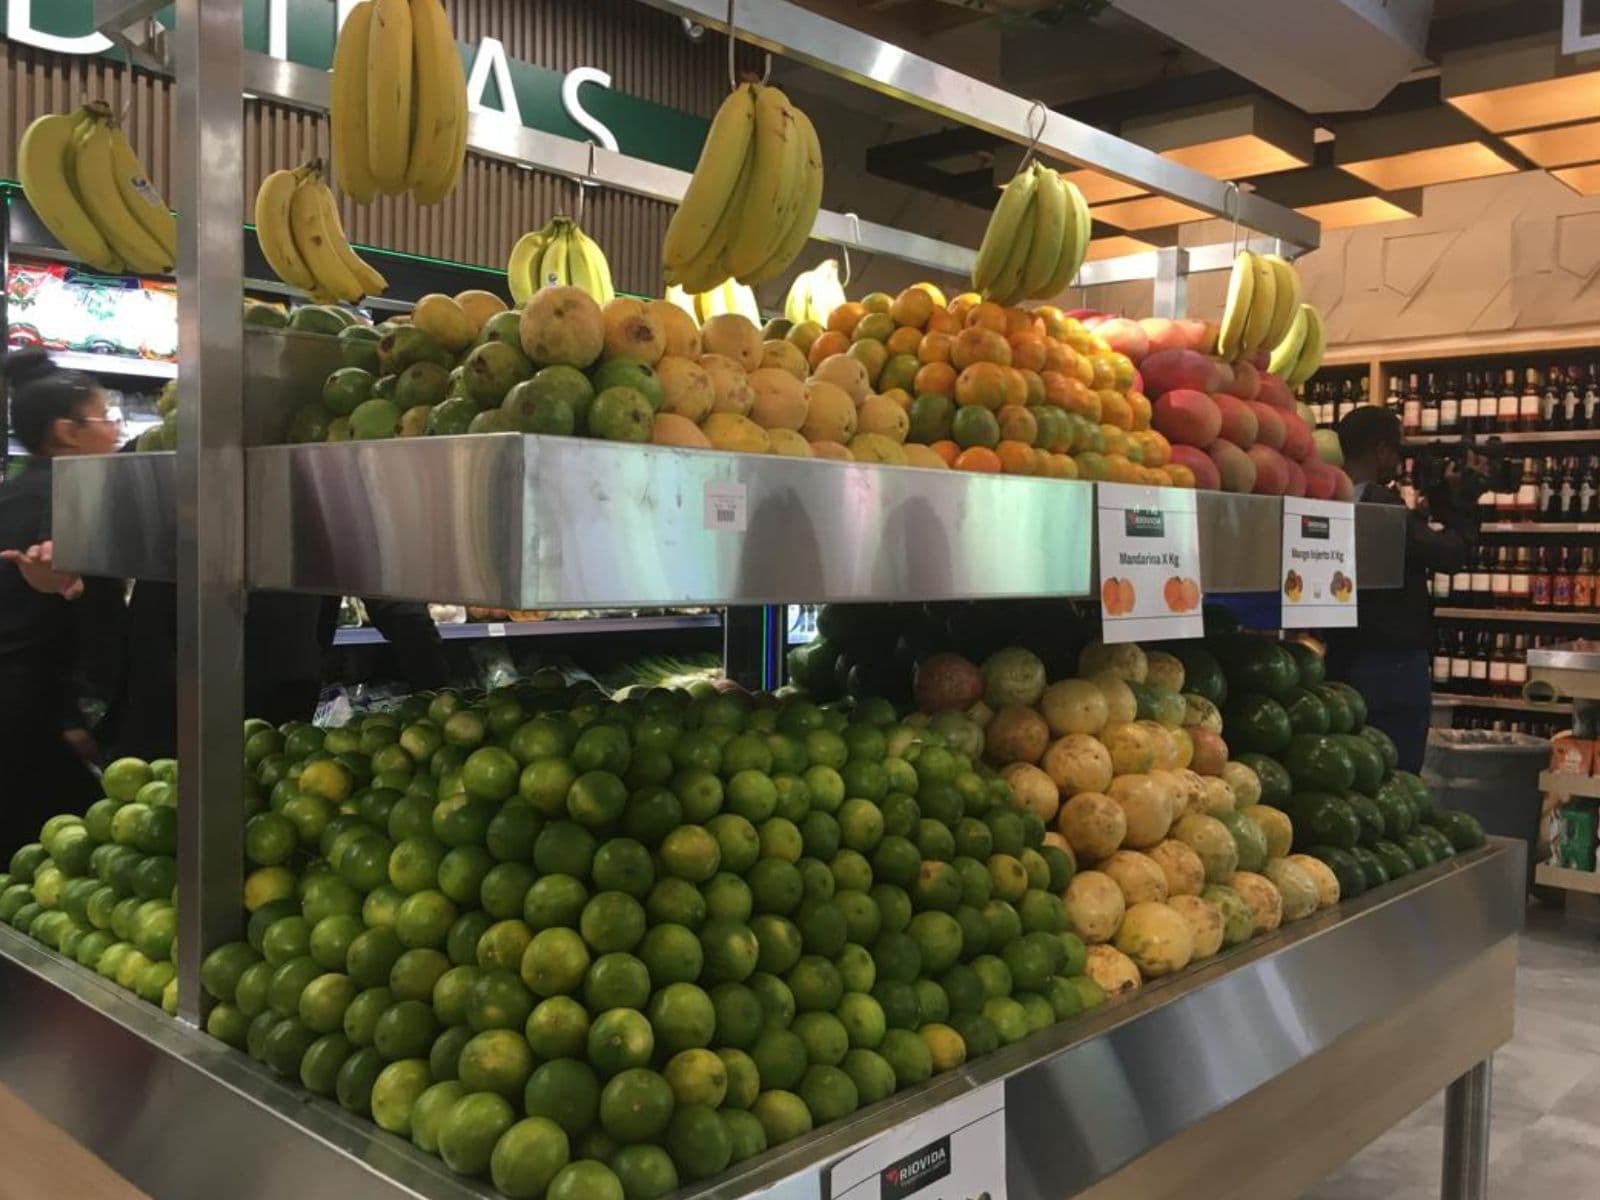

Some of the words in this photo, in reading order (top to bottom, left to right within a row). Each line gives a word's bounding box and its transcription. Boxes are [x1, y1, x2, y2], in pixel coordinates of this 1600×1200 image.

[1119, 552, 1161, 565] Mandarina
[1169, 553, 1180, 568] Kg
[900, 1147, 946, 1181] RIOVIDA
